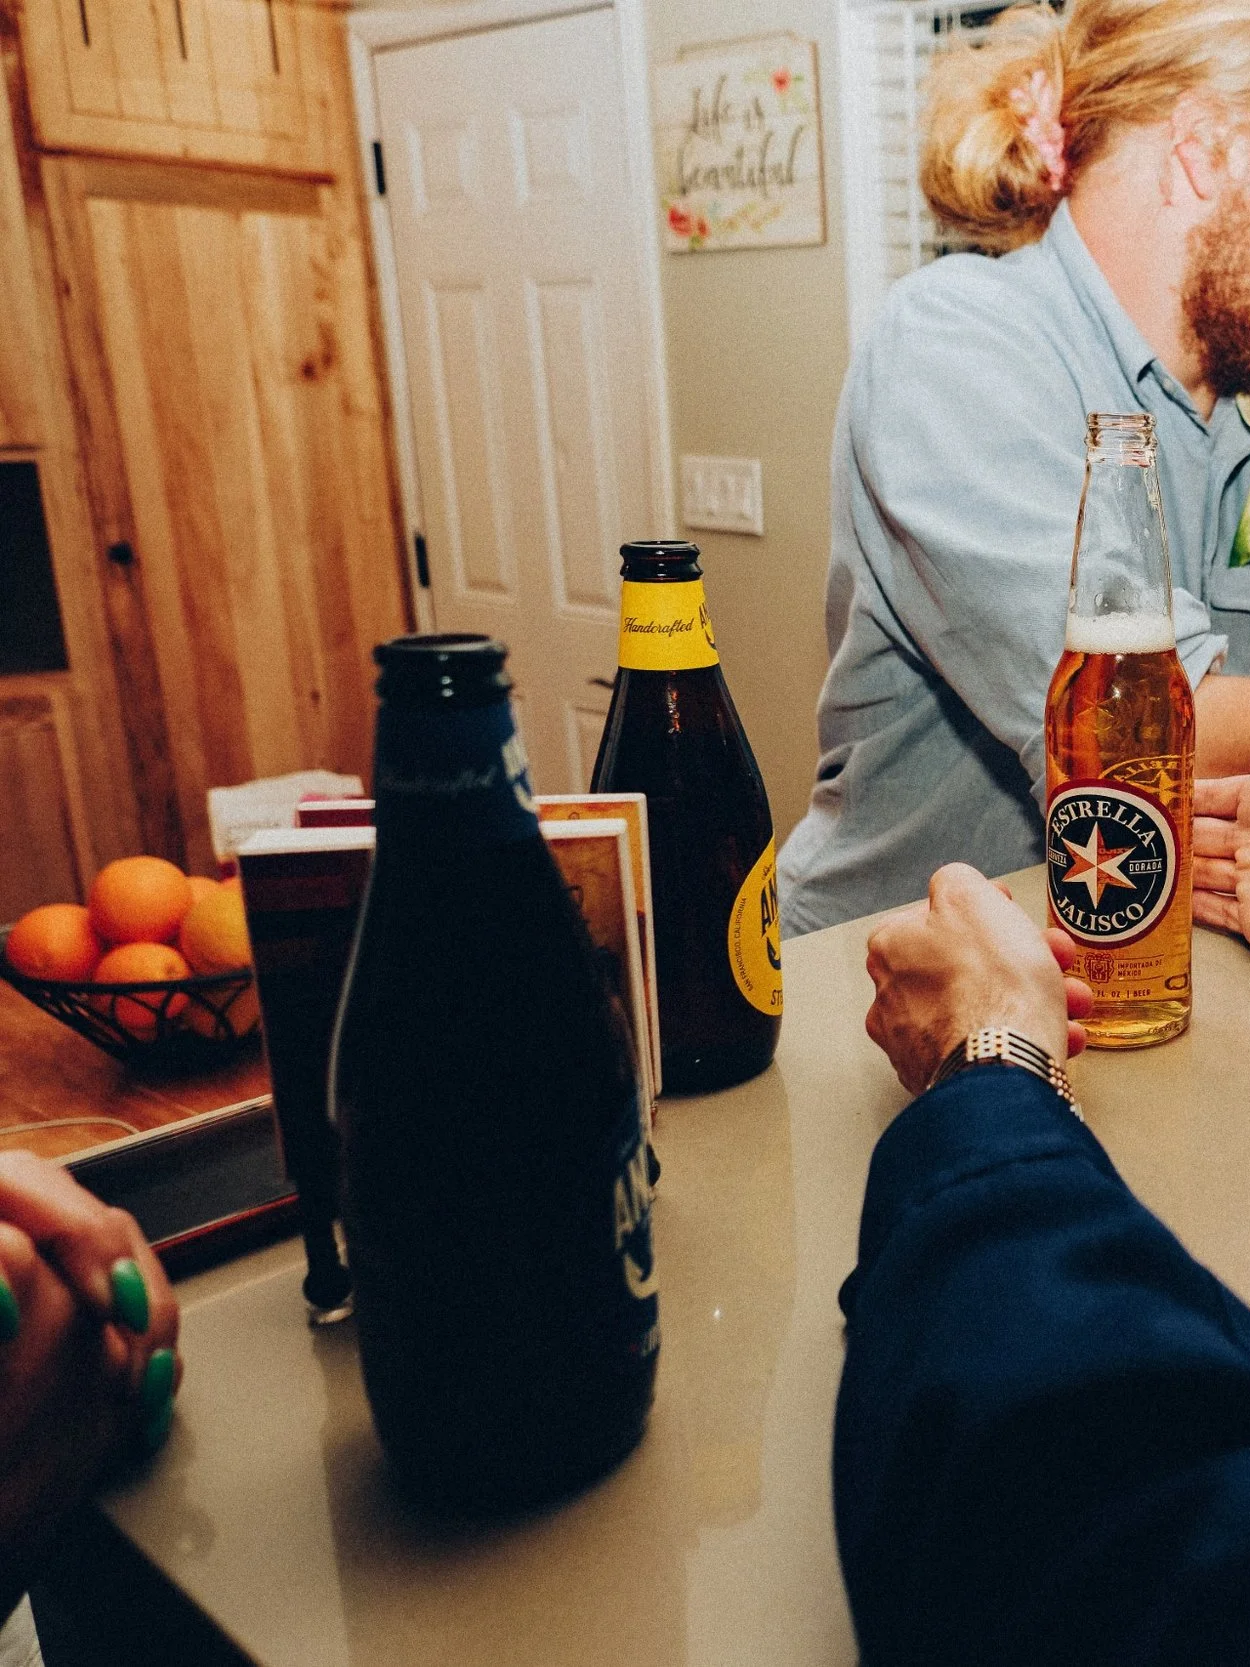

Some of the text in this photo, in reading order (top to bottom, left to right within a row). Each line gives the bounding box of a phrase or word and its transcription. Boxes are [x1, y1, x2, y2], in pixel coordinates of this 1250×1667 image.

[689, 73, 766, 143] Life is
[676, 124, 805, 199] beautiful
[623, 617, 694, 637] Handcrafted
[1051, 800, 1157, 848] ESTRELLA
[1129, 860, 1162, 873] DORADA
[1057, 895, 1145, 932] JALISCO
